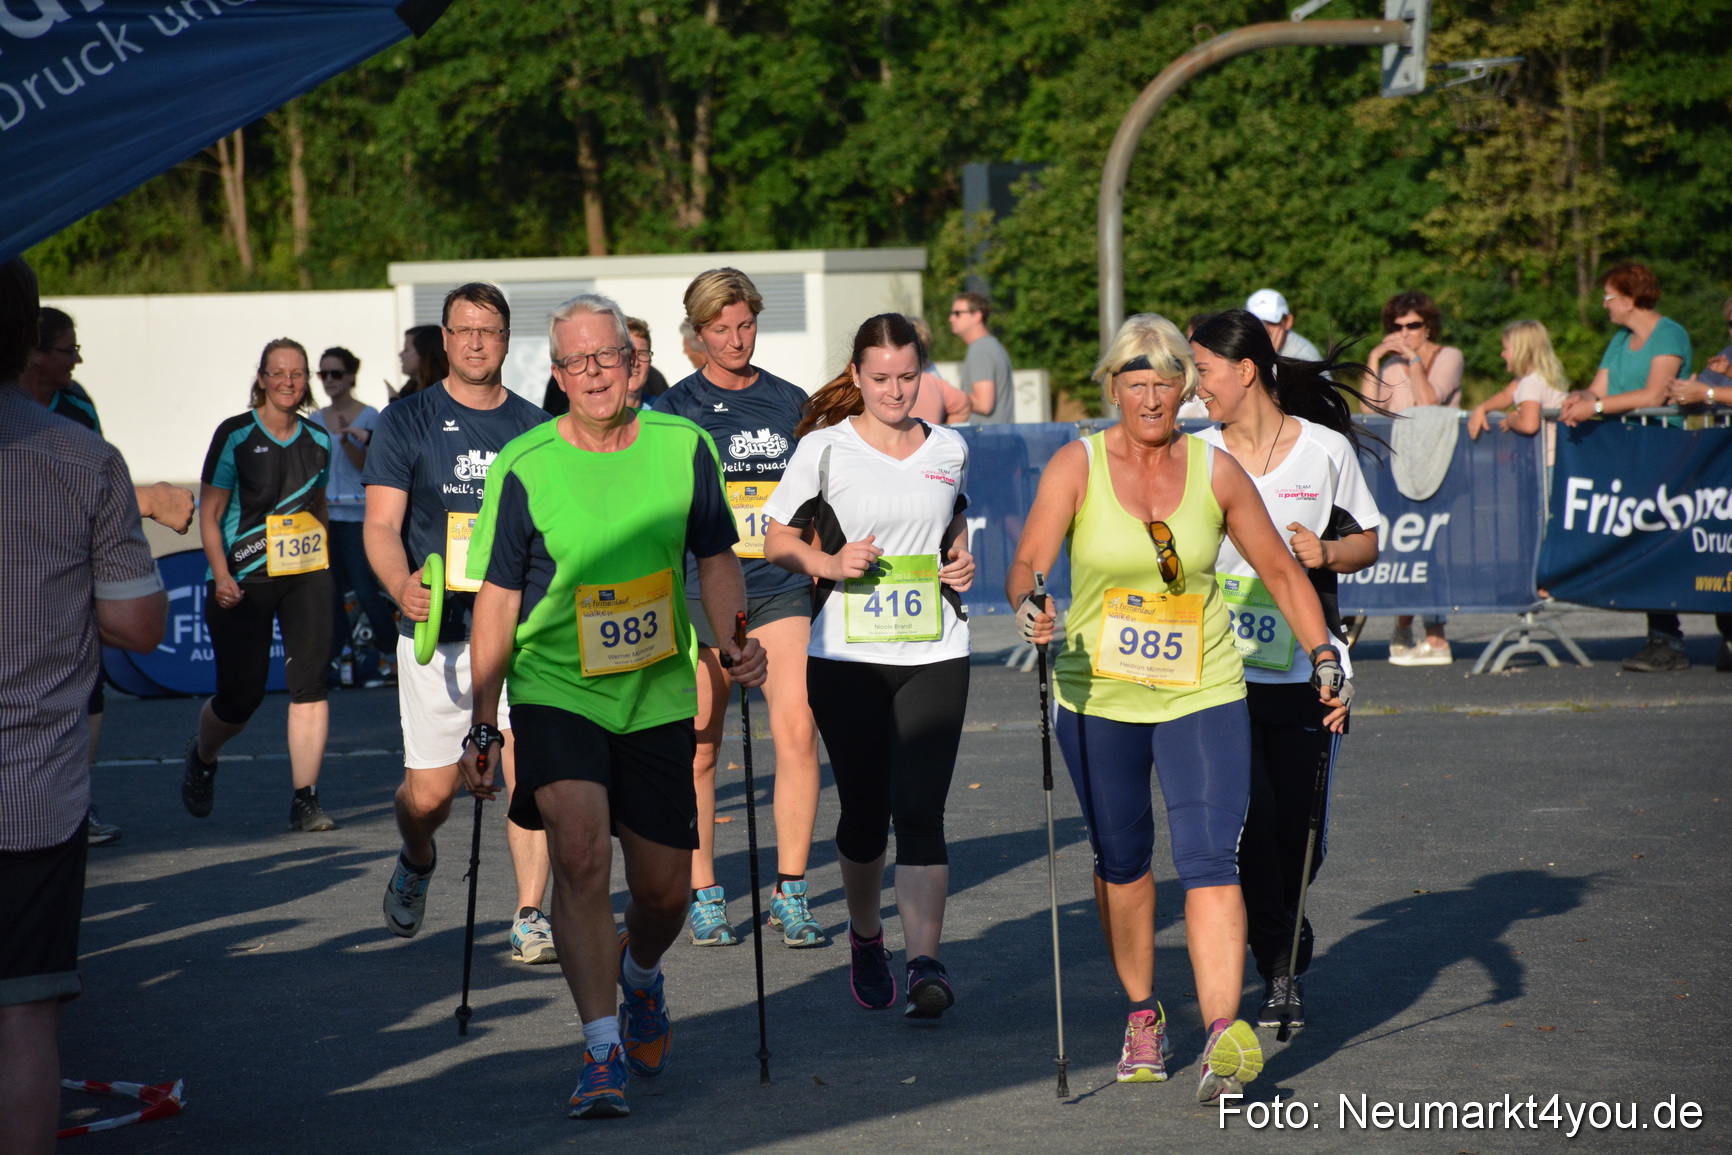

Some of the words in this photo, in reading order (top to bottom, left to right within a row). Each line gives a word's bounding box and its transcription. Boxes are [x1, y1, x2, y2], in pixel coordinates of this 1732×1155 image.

[0, 20, 144, 131] Druck
[147, 0, 252, 37] un
[729, 433, 788, 459] Burgis
[443, 483, 475, 494] Weil's
[234, 537, 268, 562] Sieben
[275, 533, 322, 558] 1362
[583, 610, 613, 618] walken
[863, 589, 922, 617] 416
[1120, 602, 1156, 615] firmenlauf
[600, 611, 658, 648] 983
[1108, 611, 1136, 623] walken
[1118, 627, 1183, 661] 985
[1120, 661, 1145, 670] Heidrun
